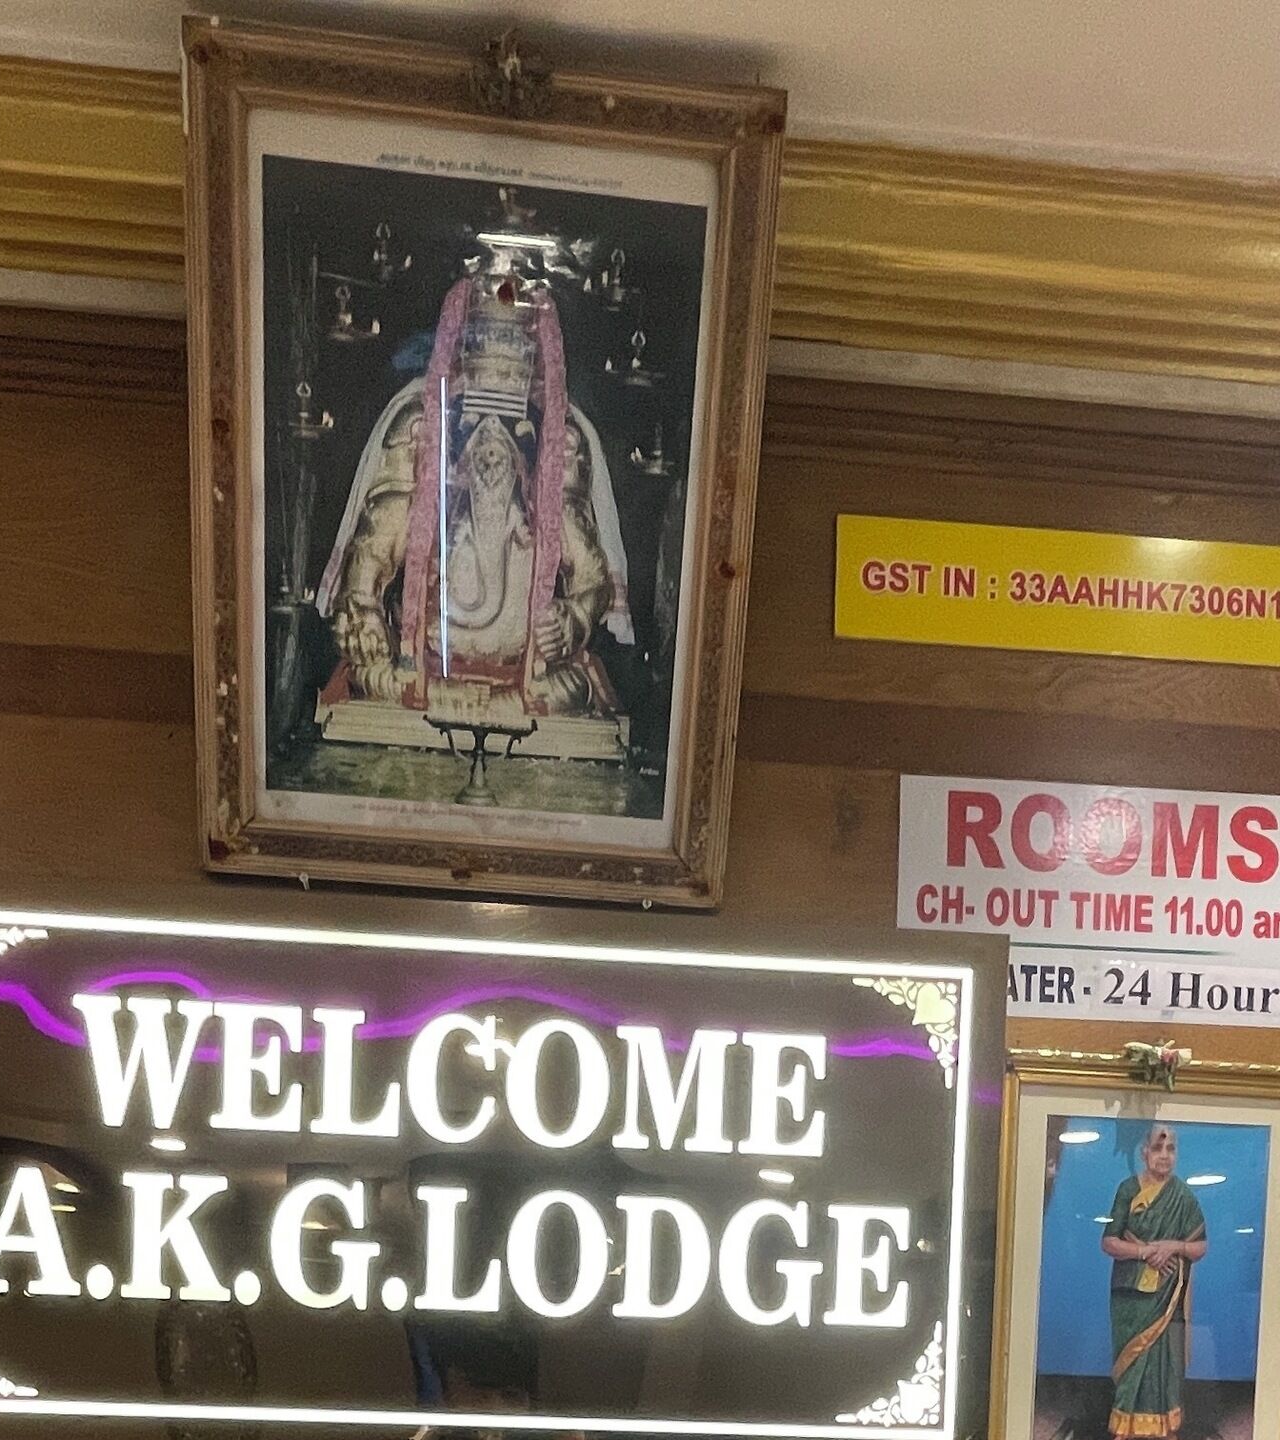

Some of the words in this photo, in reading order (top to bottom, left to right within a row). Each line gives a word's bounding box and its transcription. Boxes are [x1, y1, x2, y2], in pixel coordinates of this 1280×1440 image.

[861, 560, 932, 596] GST
[942, 566, 976, 599] IN
[945, 789, 1280, 885] ROOMS
[915, 882, 976, 925] CH-
[985, 888, 1061, 930] OUT
[1070, 892, 1154, 934] TIME
[1163, 896, 1244, 939] 11.00
[1102, 967, 1152, 1007] 24
[72, 993, 828, 1160] WELCOME
